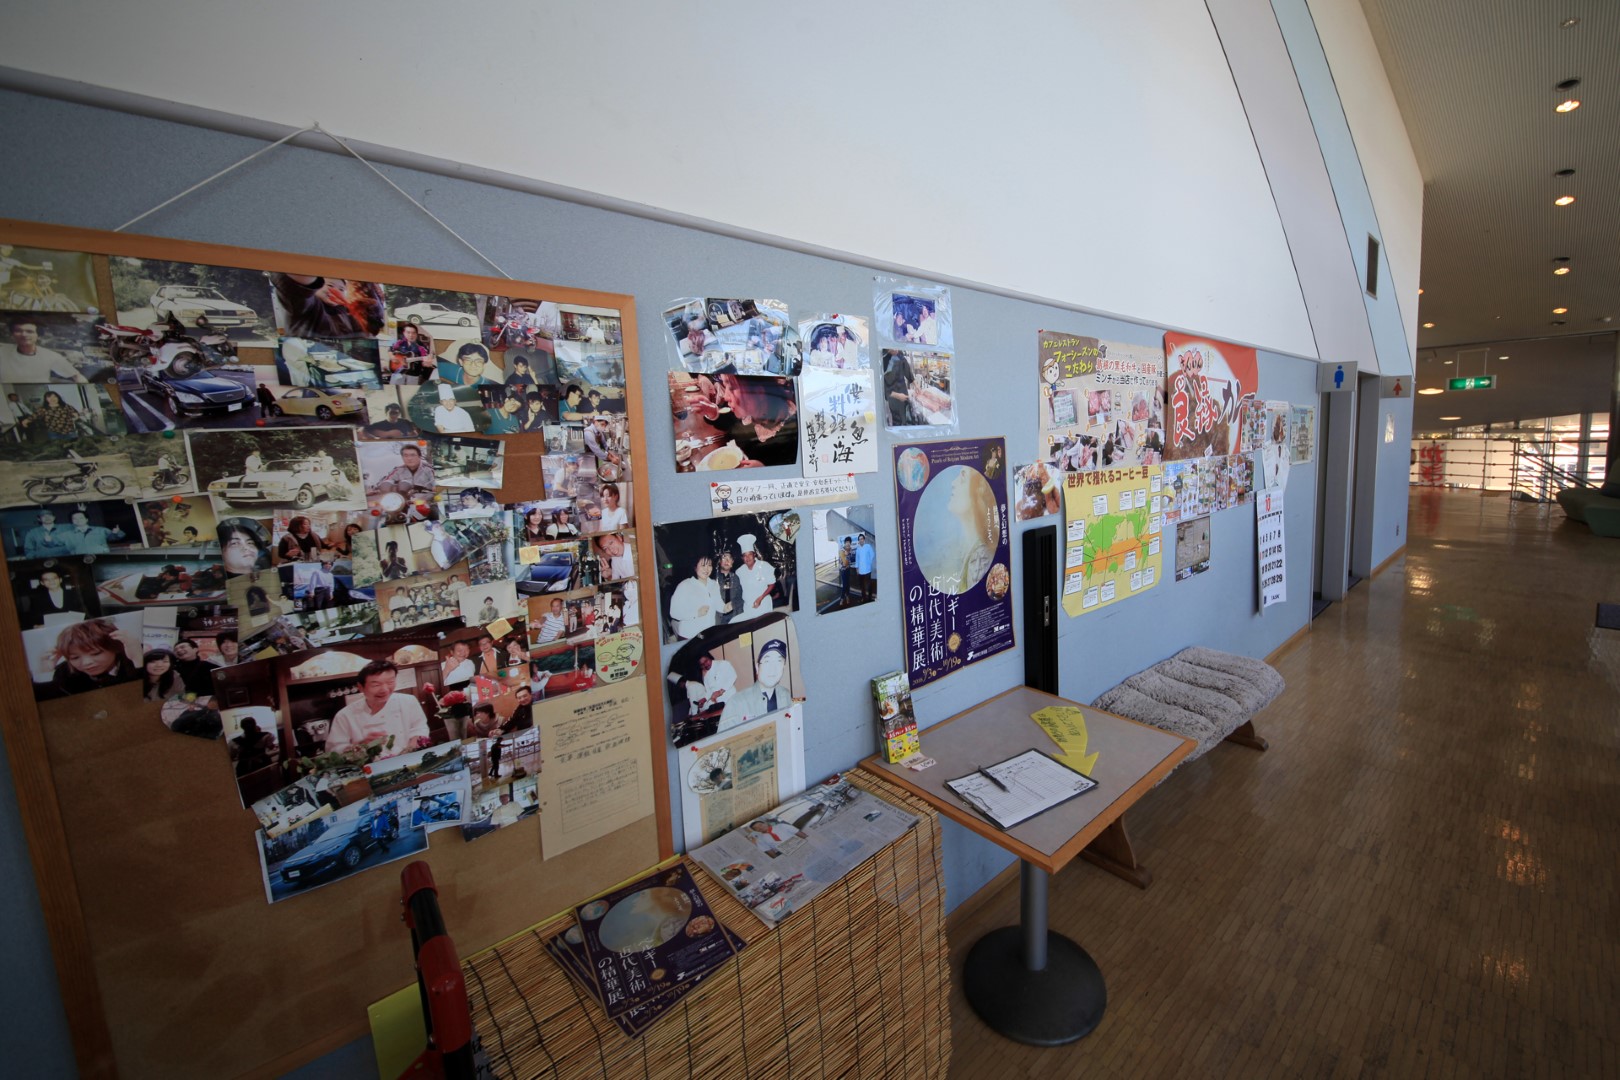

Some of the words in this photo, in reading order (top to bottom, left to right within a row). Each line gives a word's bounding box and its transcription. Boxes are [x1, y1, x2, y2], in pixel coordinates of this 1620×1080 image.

[1053, 346, 1099, 363] フォーシーズンの
[1065, 360, 1093, 378] こだわり
[1067, 466, 1149, 489] 世界で獲れるコーヒー豆
[928, 576, 944, 663] 近代美術
[946, 573, 962, 631] ベルギー
[909, 585, 926, 672] の精華展
